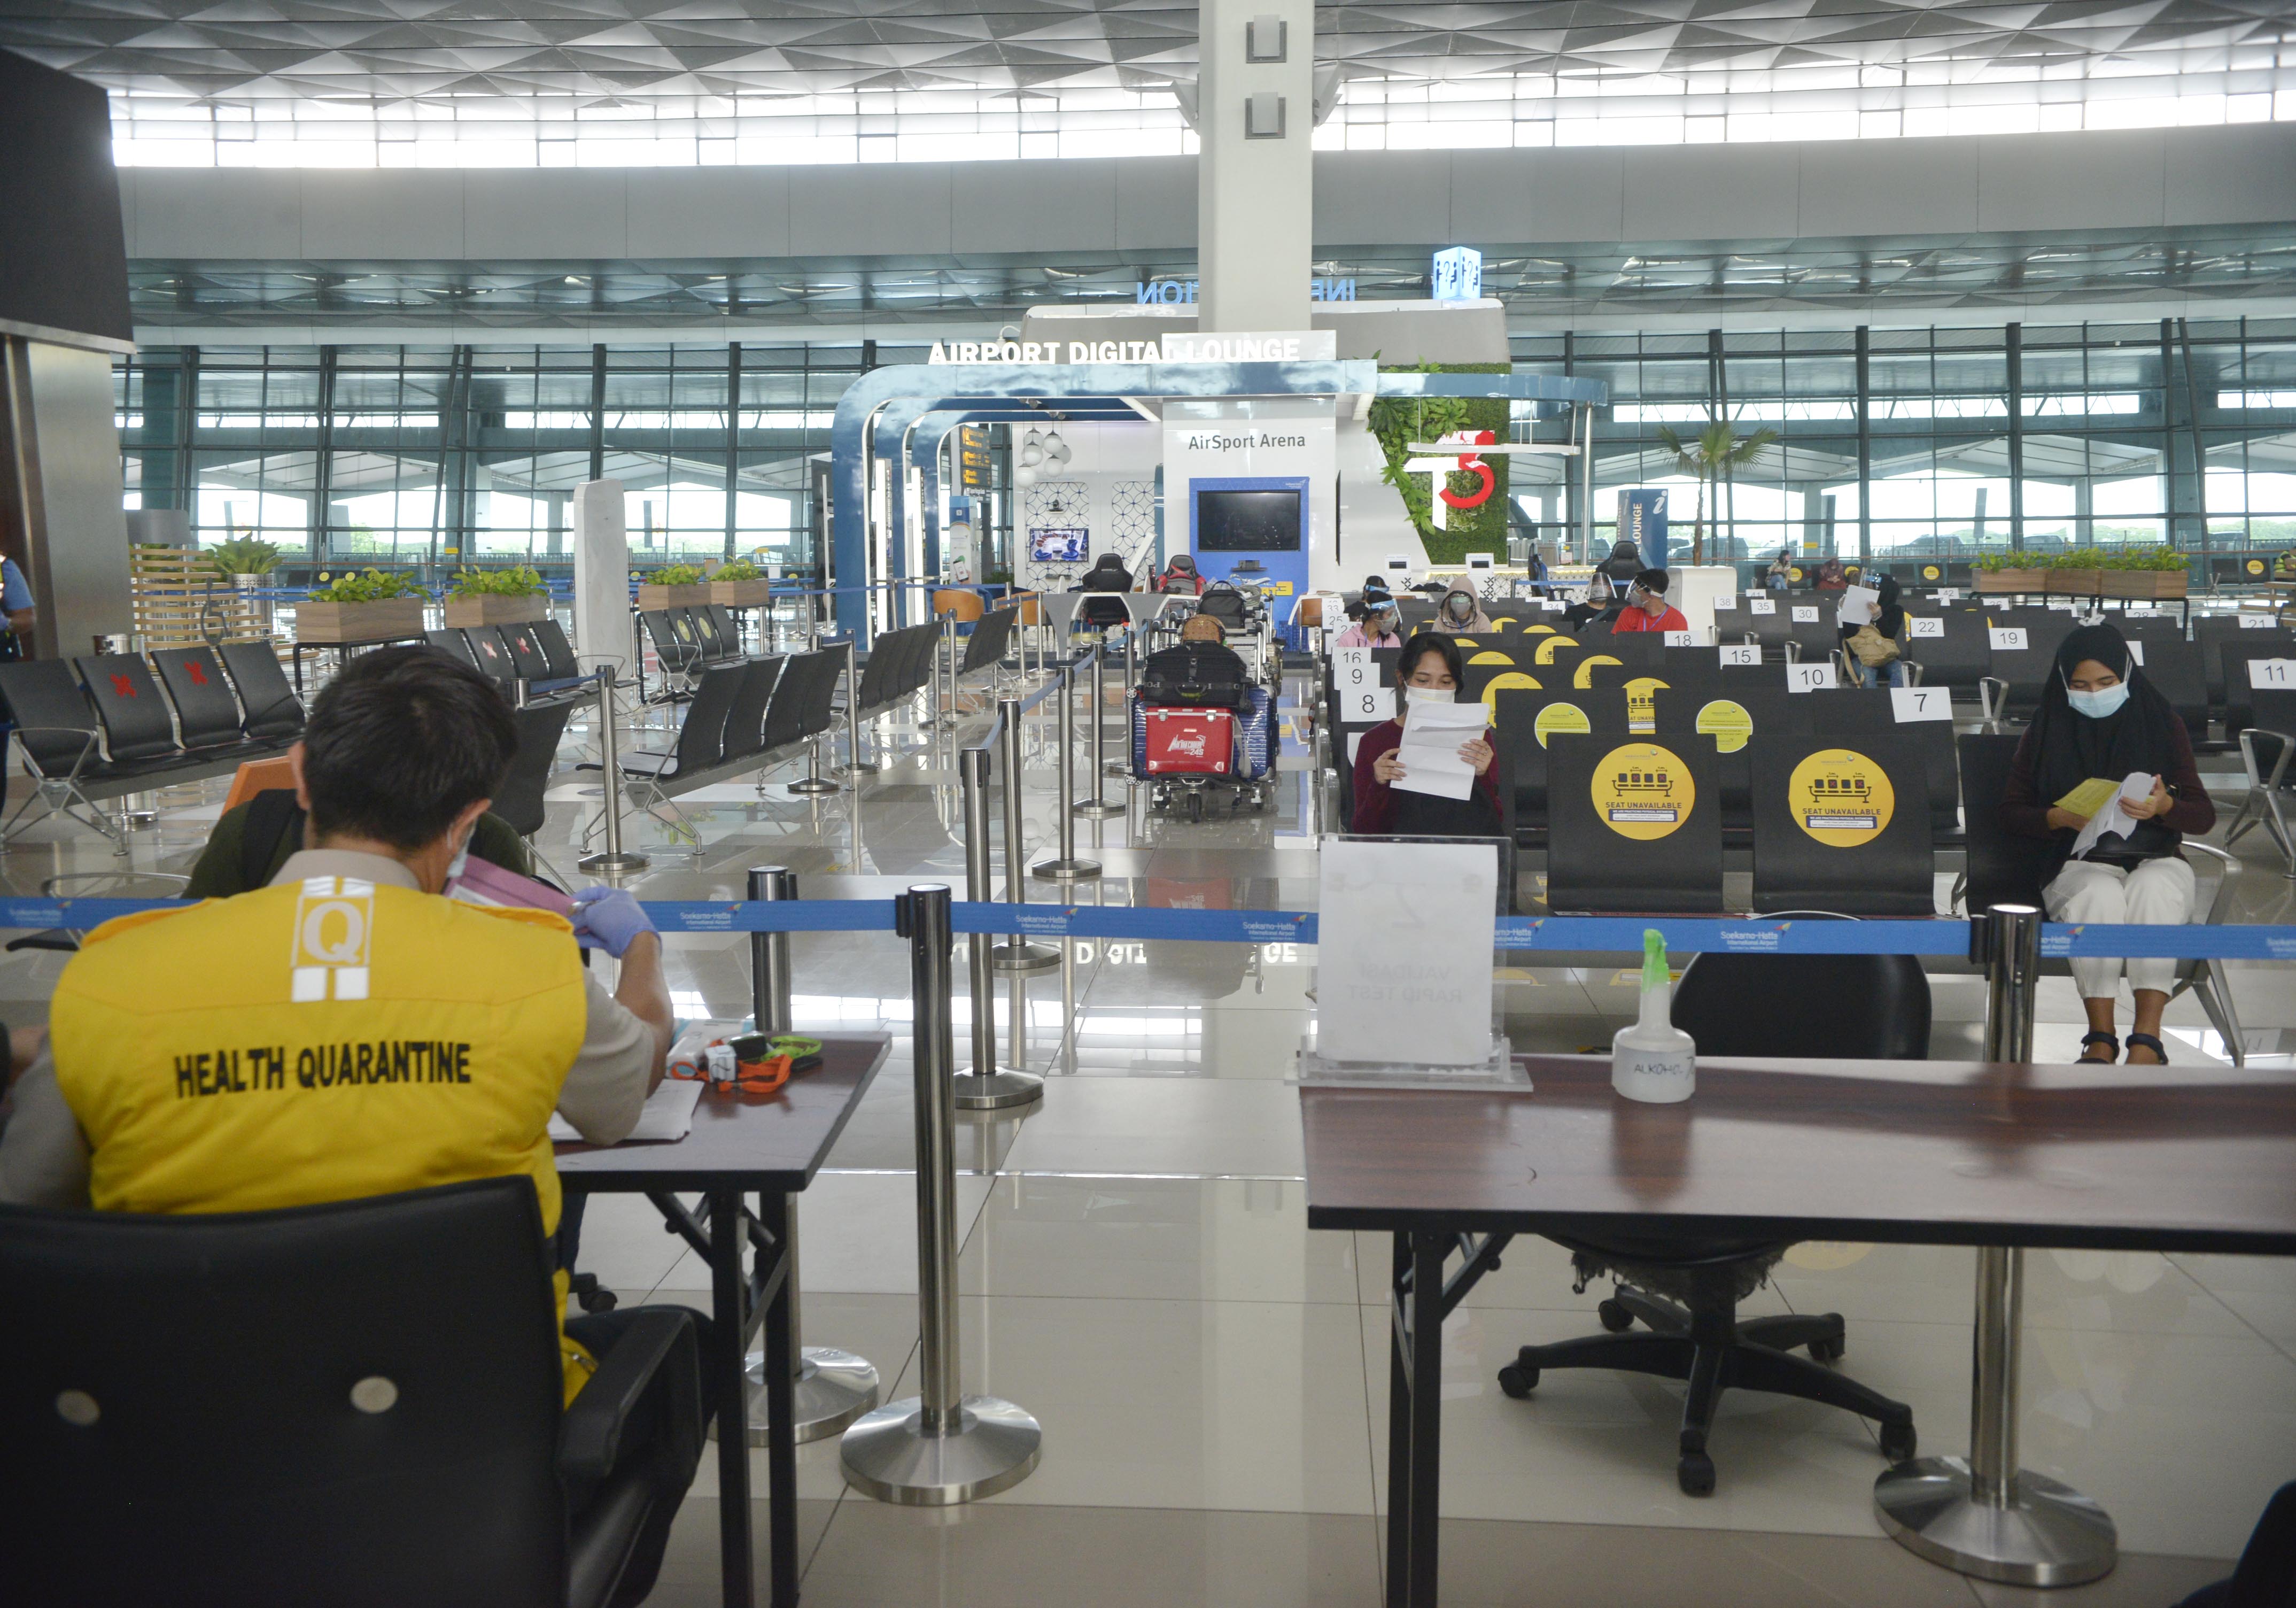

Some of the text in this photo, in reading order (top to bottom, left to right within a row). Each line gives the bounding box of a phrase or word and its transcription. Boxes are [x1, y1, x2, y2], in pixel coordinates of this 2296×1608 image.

[928, 338, 1300, 365] AIRPORT DIGITAL LOUNGE
[1188, 434, 1306, 452] AirSport Arena
[1632, 502, 1642, 545] LOUNGE
[1757, 602, 1770, 610] 35
[1798, 609, 1812, 618] 30
[1918, 621, 1935, 632] 22
[1674, 635, 1692, 647] 18
[2000, 632, 2018, 644] 19
[1343, 651, 1361, 663] 16
[1731, 650, 1751, 663] 15
[1352, 668, 1362, 684] 9
[1801, 669, 1824, 685] 10
[2264, 665, 2285, 682] 11
[1362, 694, 1375, 713] 8
[1914, 693, 1927, 713] 7
[302, 901, 364, 963] Q
[174, 1041, 472, 1099] HEALTH QUARANTINE
